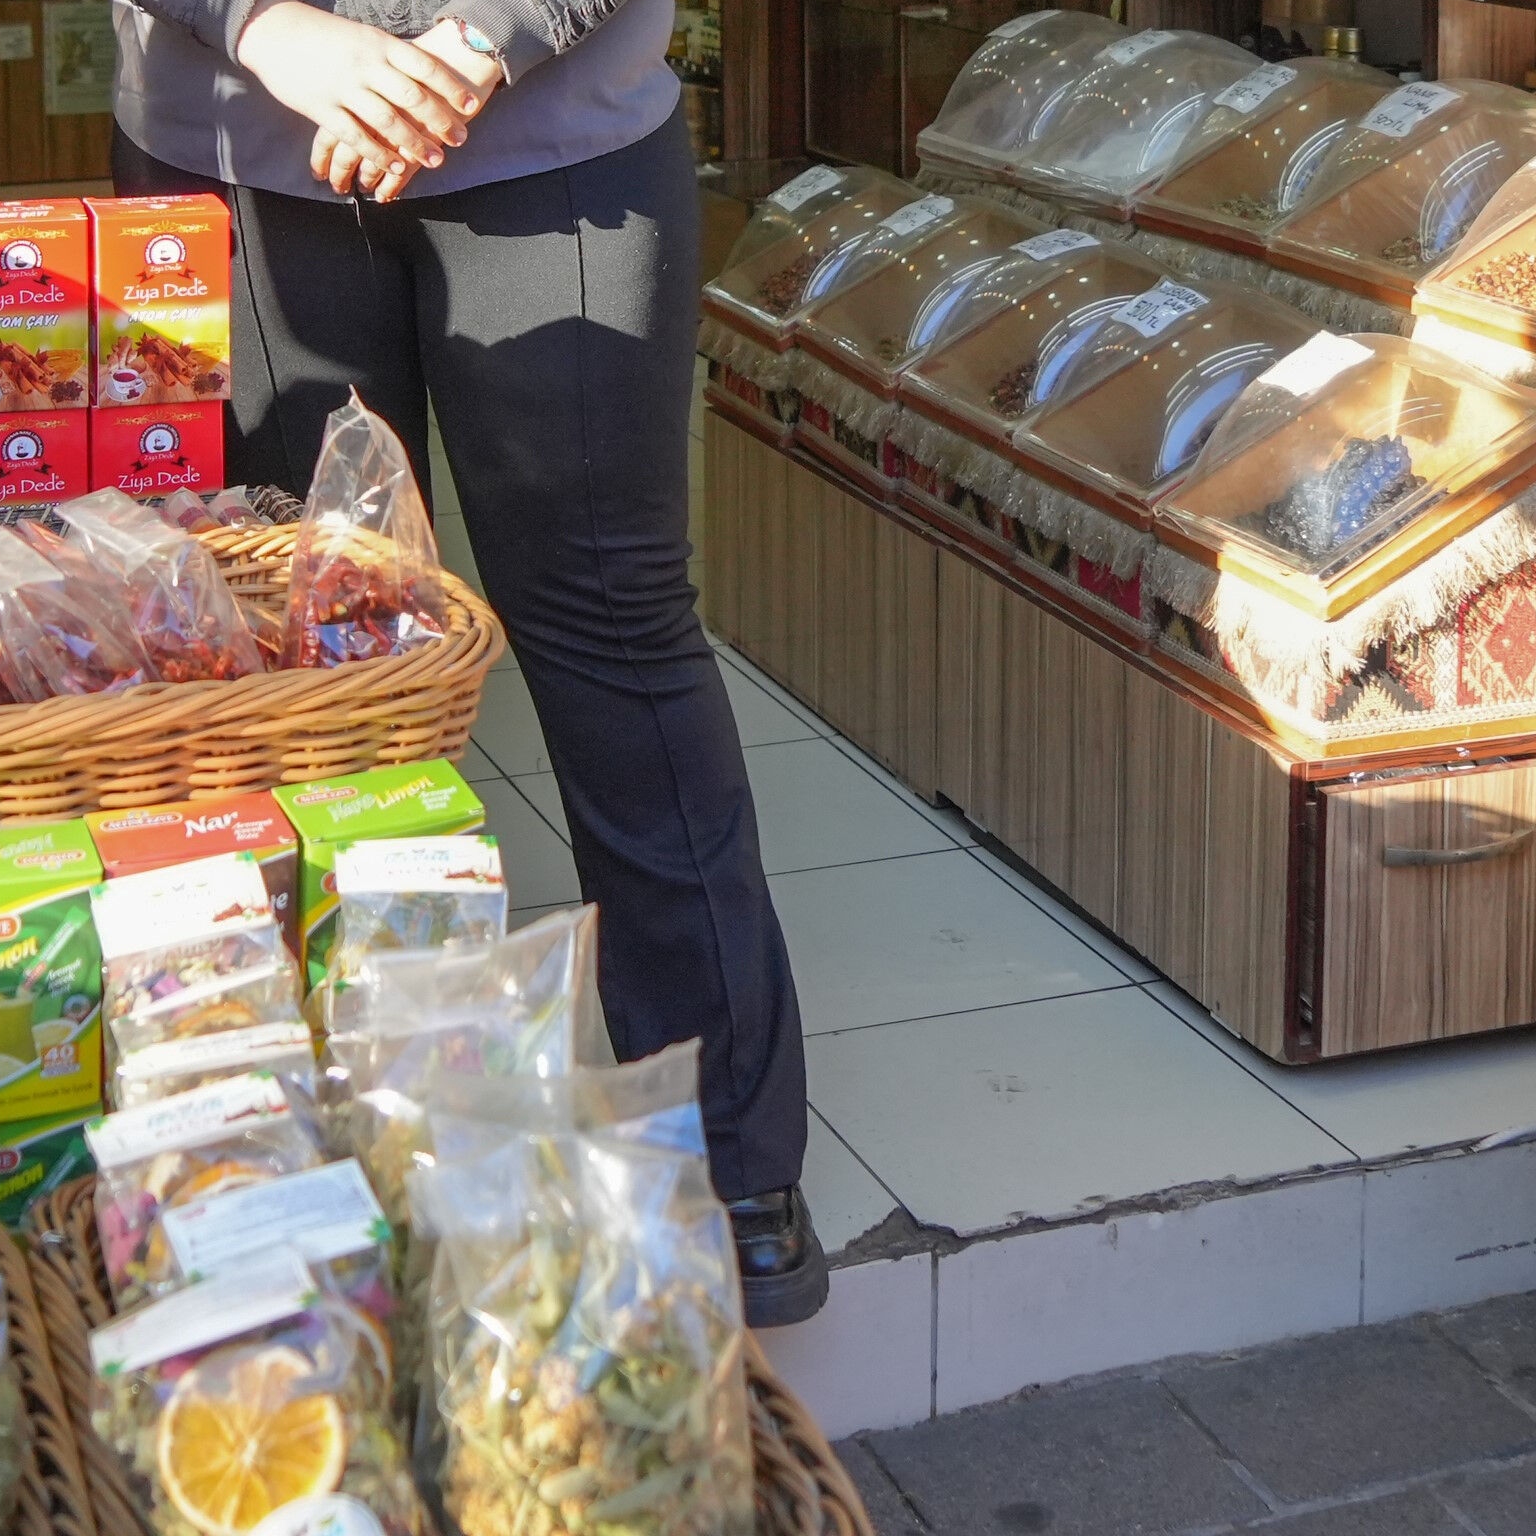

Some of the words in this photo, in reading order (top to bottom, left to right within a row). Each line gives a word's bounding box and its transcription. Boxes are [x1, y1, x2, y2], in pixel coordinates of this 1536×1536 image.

[19, 284, 65, 304] Dede
[124, 284, 159, 307] Ziya
[164, 278, 208, 296] Dede
[25, 314, 59, 329] ÇAYI
[20, 473, 66, 493] Dede
[118, 473, 154, 496] Ziya
[157, 466, 201, 487] Dede
[184, 810, 240, 838] Nar
